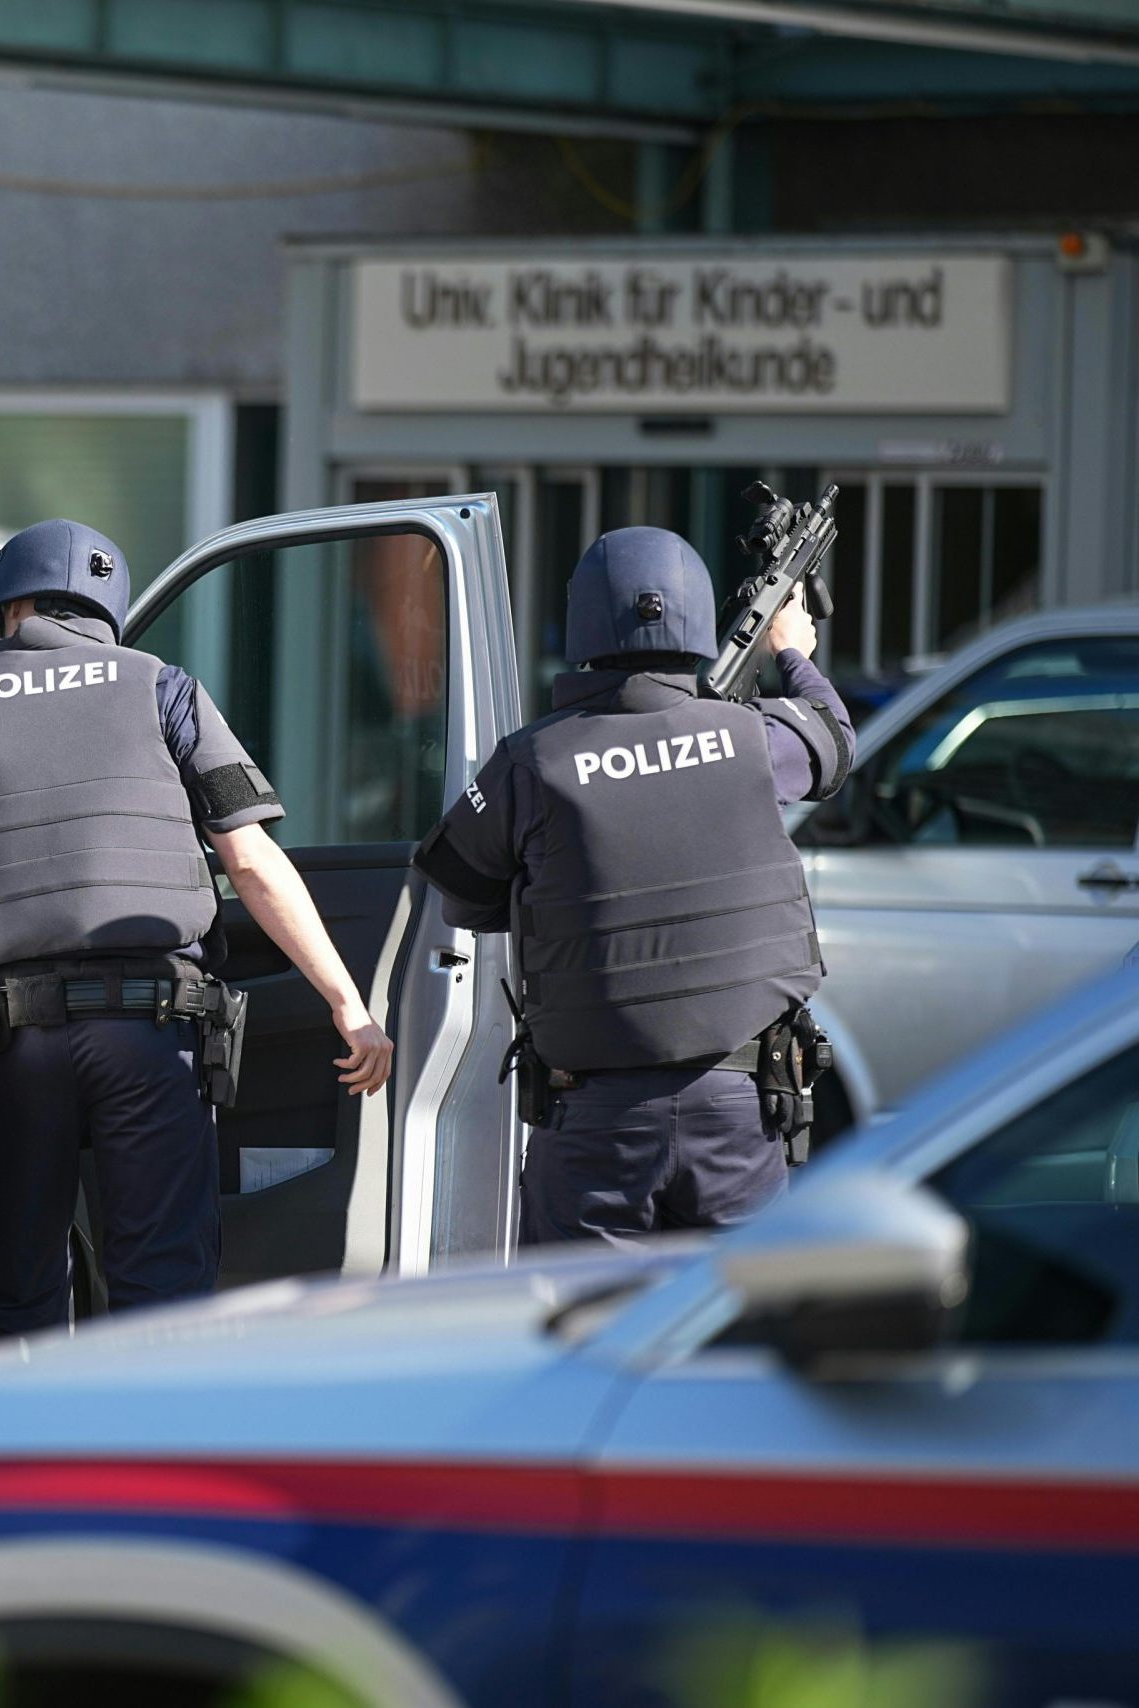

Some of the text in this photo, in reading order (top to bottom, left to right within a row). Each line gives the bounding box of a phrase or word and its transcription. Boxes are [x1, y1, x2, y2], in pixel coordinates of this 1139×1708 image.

[507, 266, 612, 330] Klinik
[625, 264, 680, 329] für
[864, 263, 943, 330] und
[497, 335, 837, 406] Jugendheilkunde
[573, 728, 736, 785] POLIZEI
[466, 781, 487, 814] ZEI
